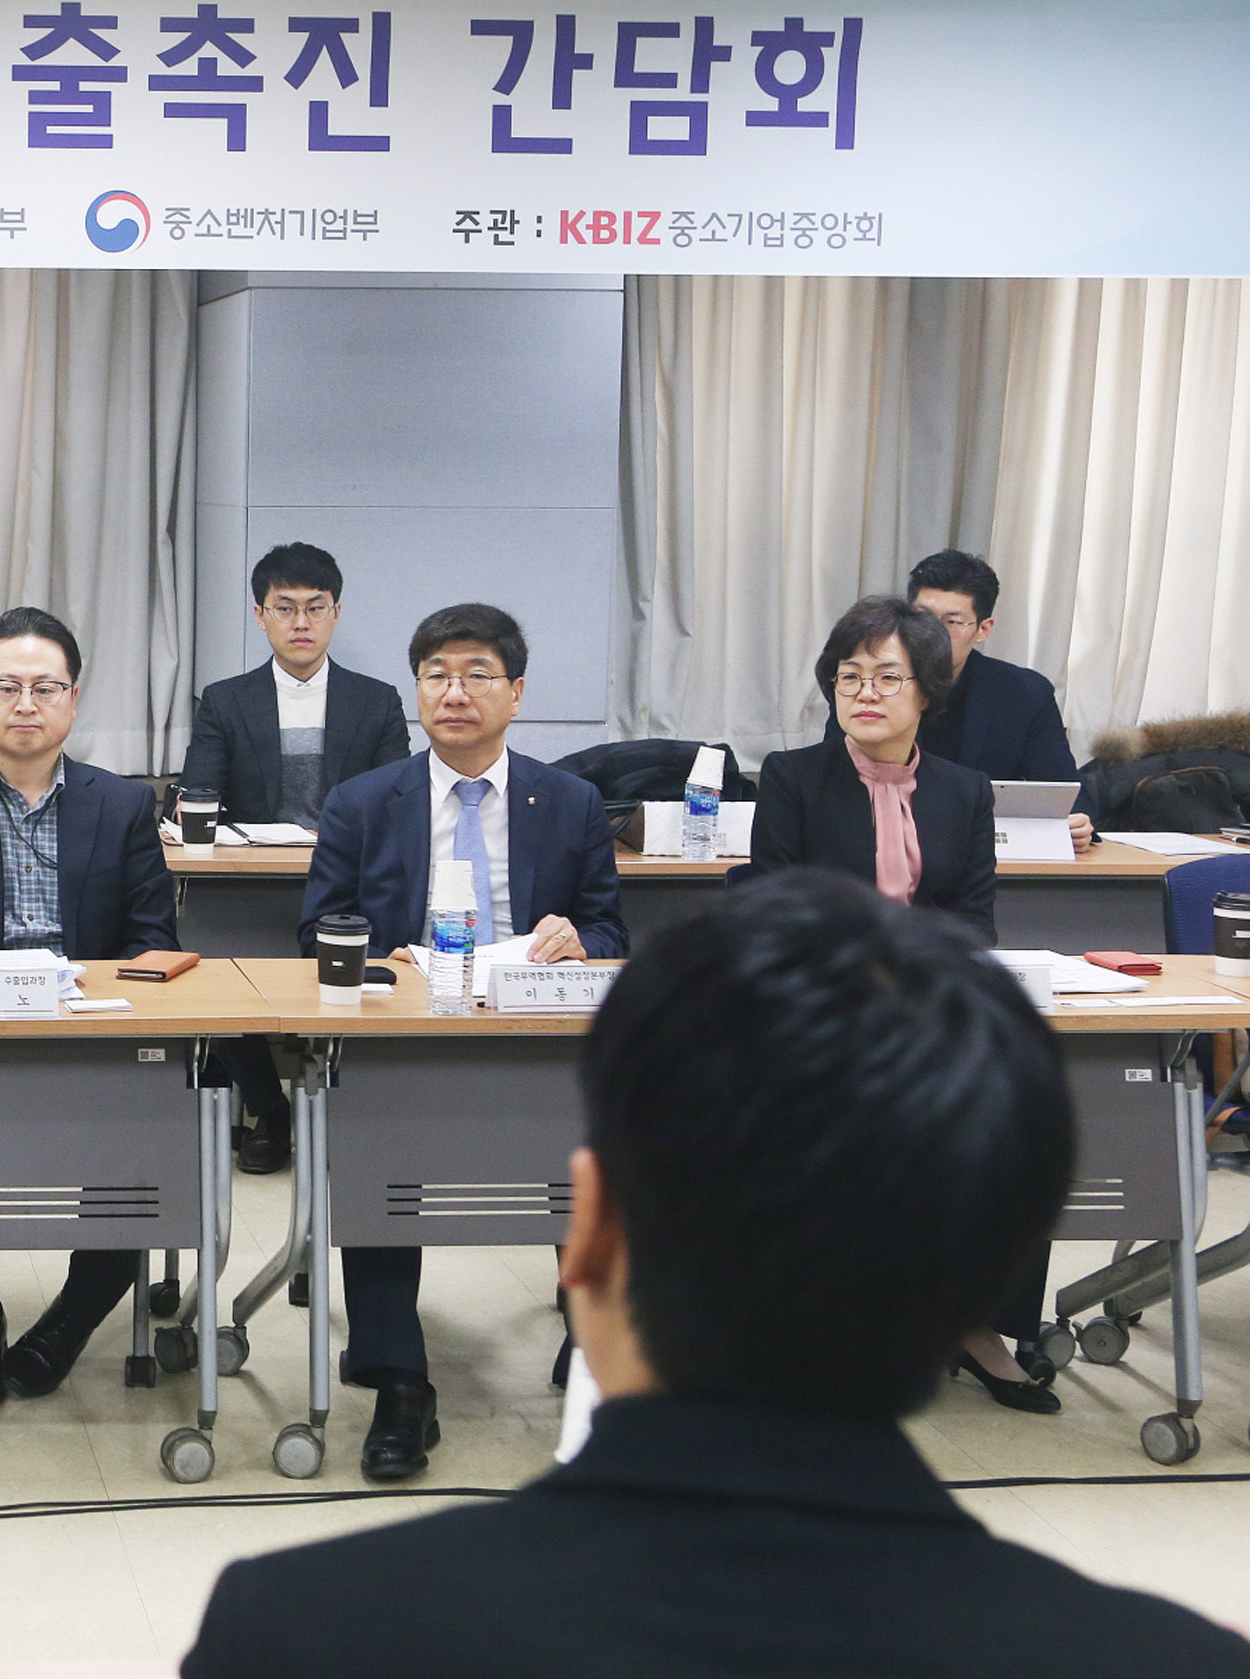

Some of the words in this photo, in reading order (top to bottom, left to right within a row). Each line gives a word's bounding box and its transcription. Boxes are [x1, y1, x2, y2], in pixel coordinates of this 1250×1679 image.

[470, 14, 864, 156] 간담회
[162, 207, 380, 242] 중소벤처기업부
[667, 210, 884, 250] 중소기업중앙회
[4, 975, 47, 986] 수출입과장
[503, 971, 554, 982] 한국무역협회
